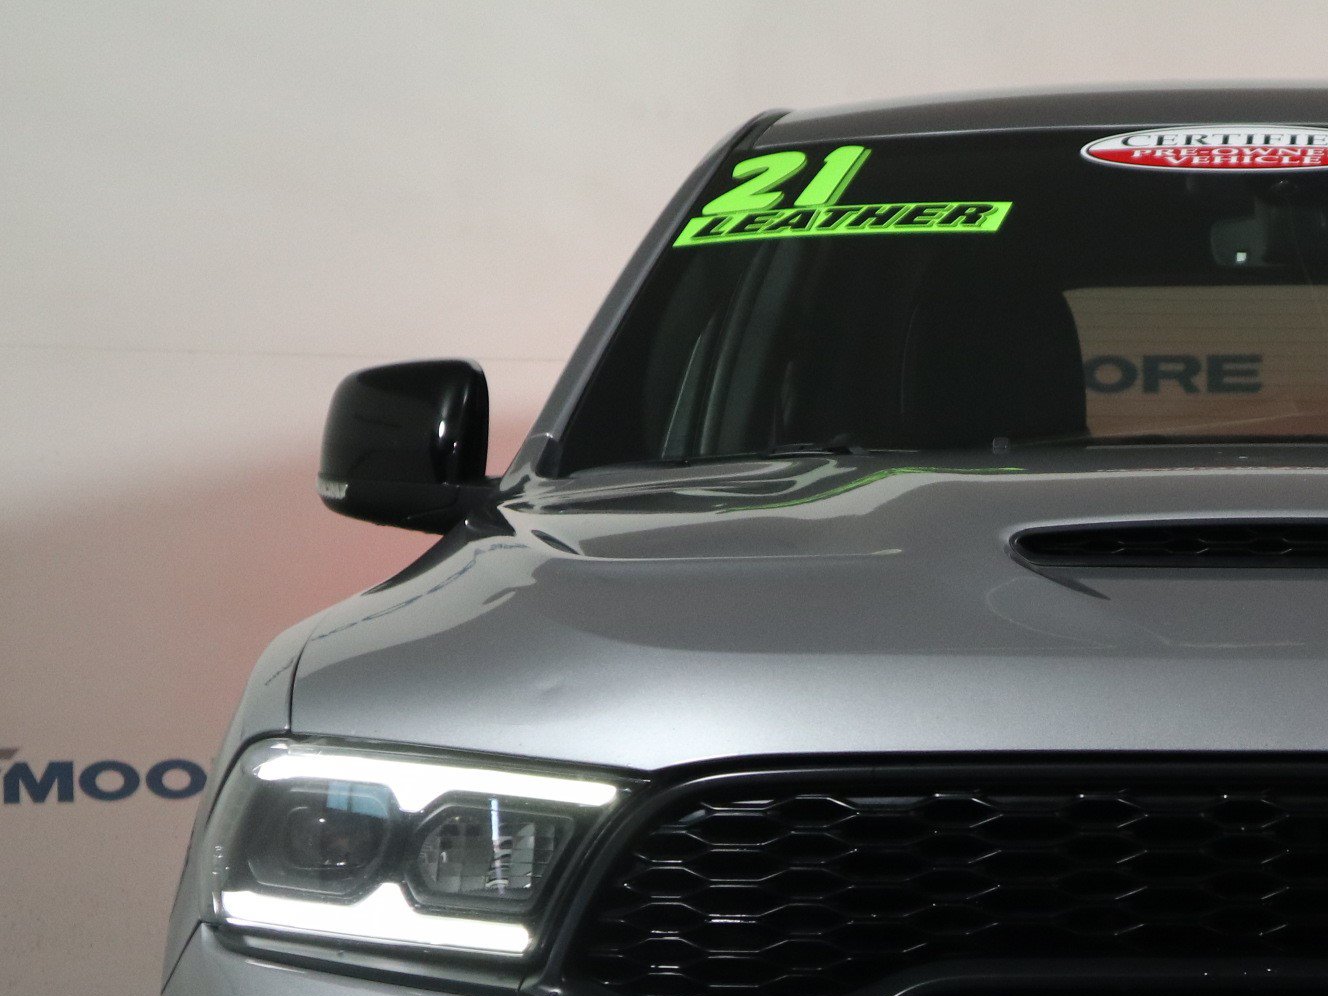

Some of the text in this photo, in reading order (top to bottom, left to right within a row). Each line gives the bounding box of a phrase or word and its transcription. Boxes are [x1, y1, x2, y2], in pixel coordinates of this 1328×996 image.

[701, 145, 872, 216] 21
[1166, 155, 1323, 165] VEHICLE
[689, 203, 999, 240] LEATHER
[2, 758, 208, 804] MOO
